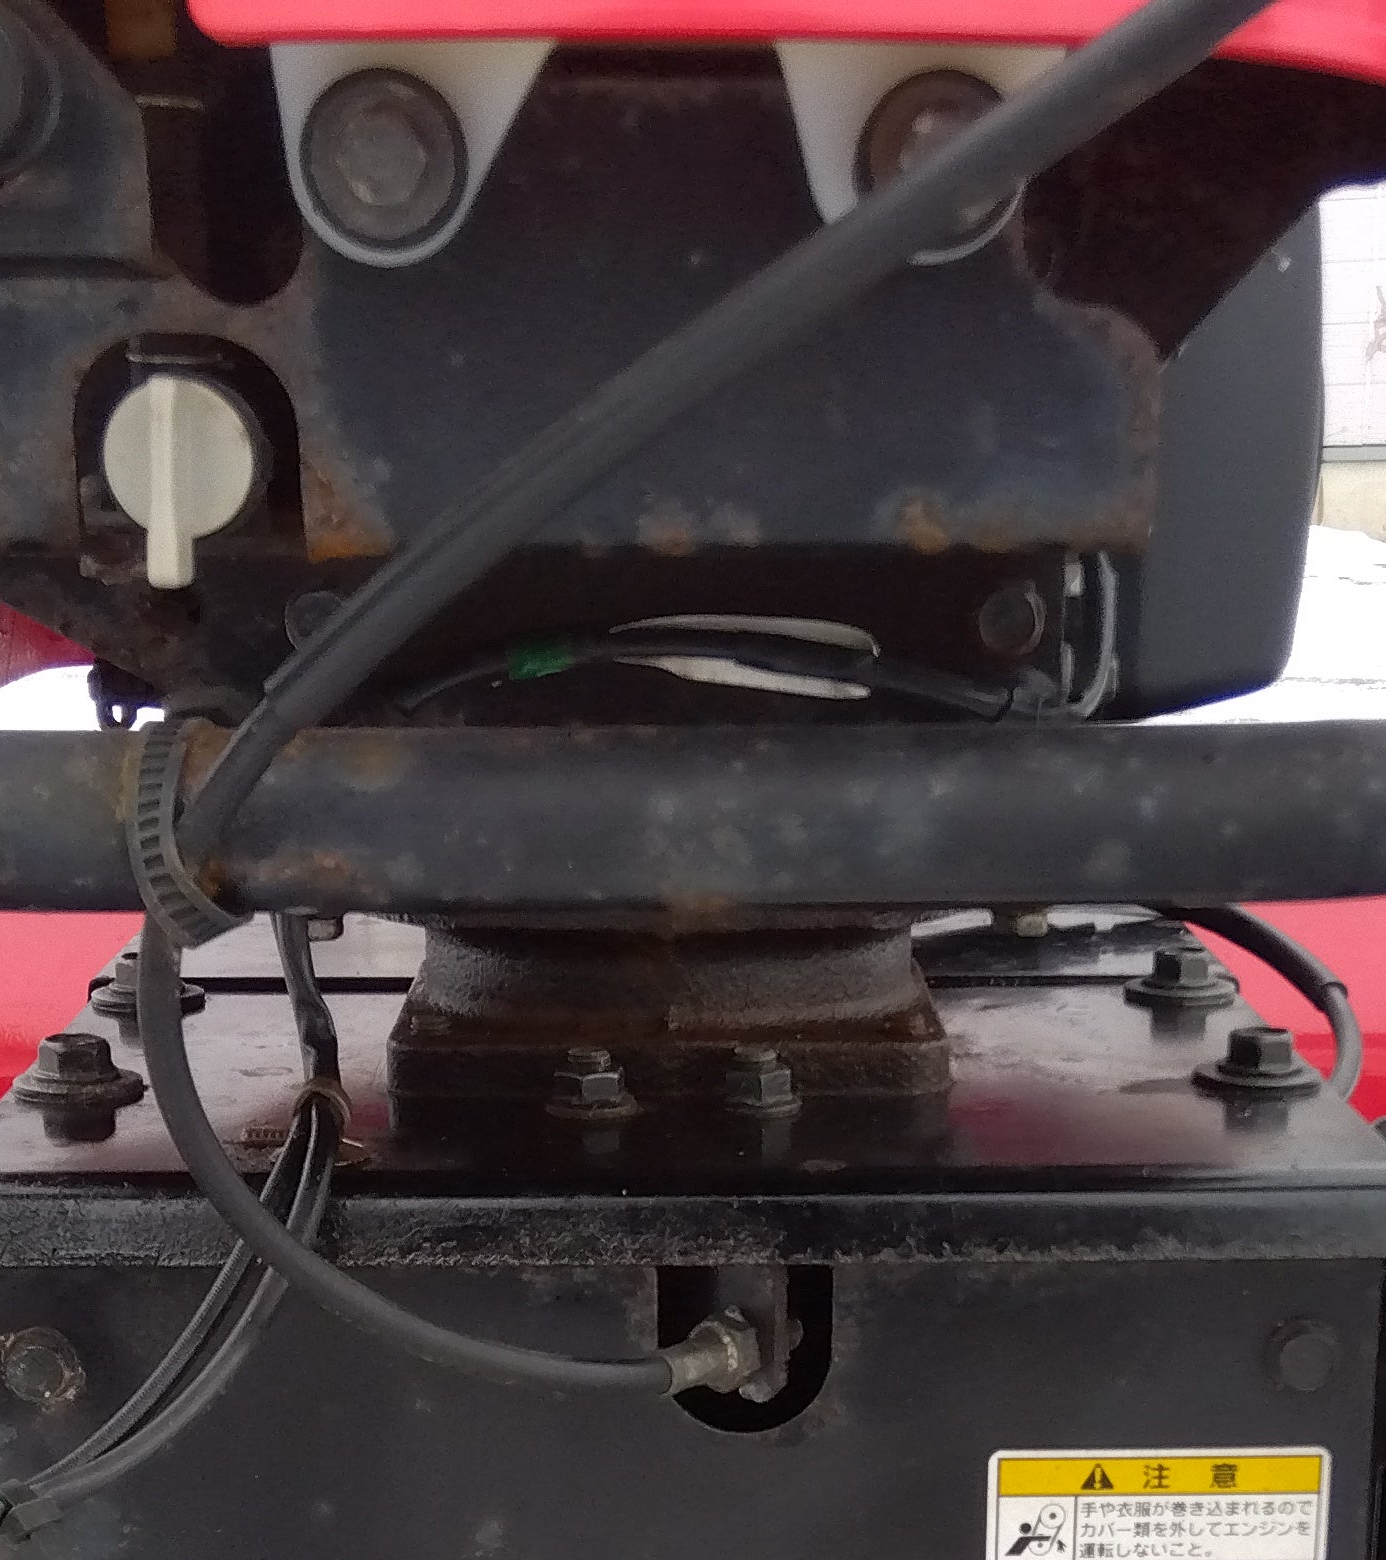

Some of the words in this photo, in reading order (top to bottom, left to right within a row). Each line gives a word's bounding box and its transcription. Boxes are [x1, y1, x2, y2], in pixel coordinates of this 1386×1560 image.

[1143, 1463, 1239, 1489] 注意
[1080, 1501, 1313, 1517] 手や衣服が巻き込まれるので
[1080, 1521, 1310, 1539] カバー類を外してエンジンを
[1079, 1542, 1213, 1559] 運転しないこと。
